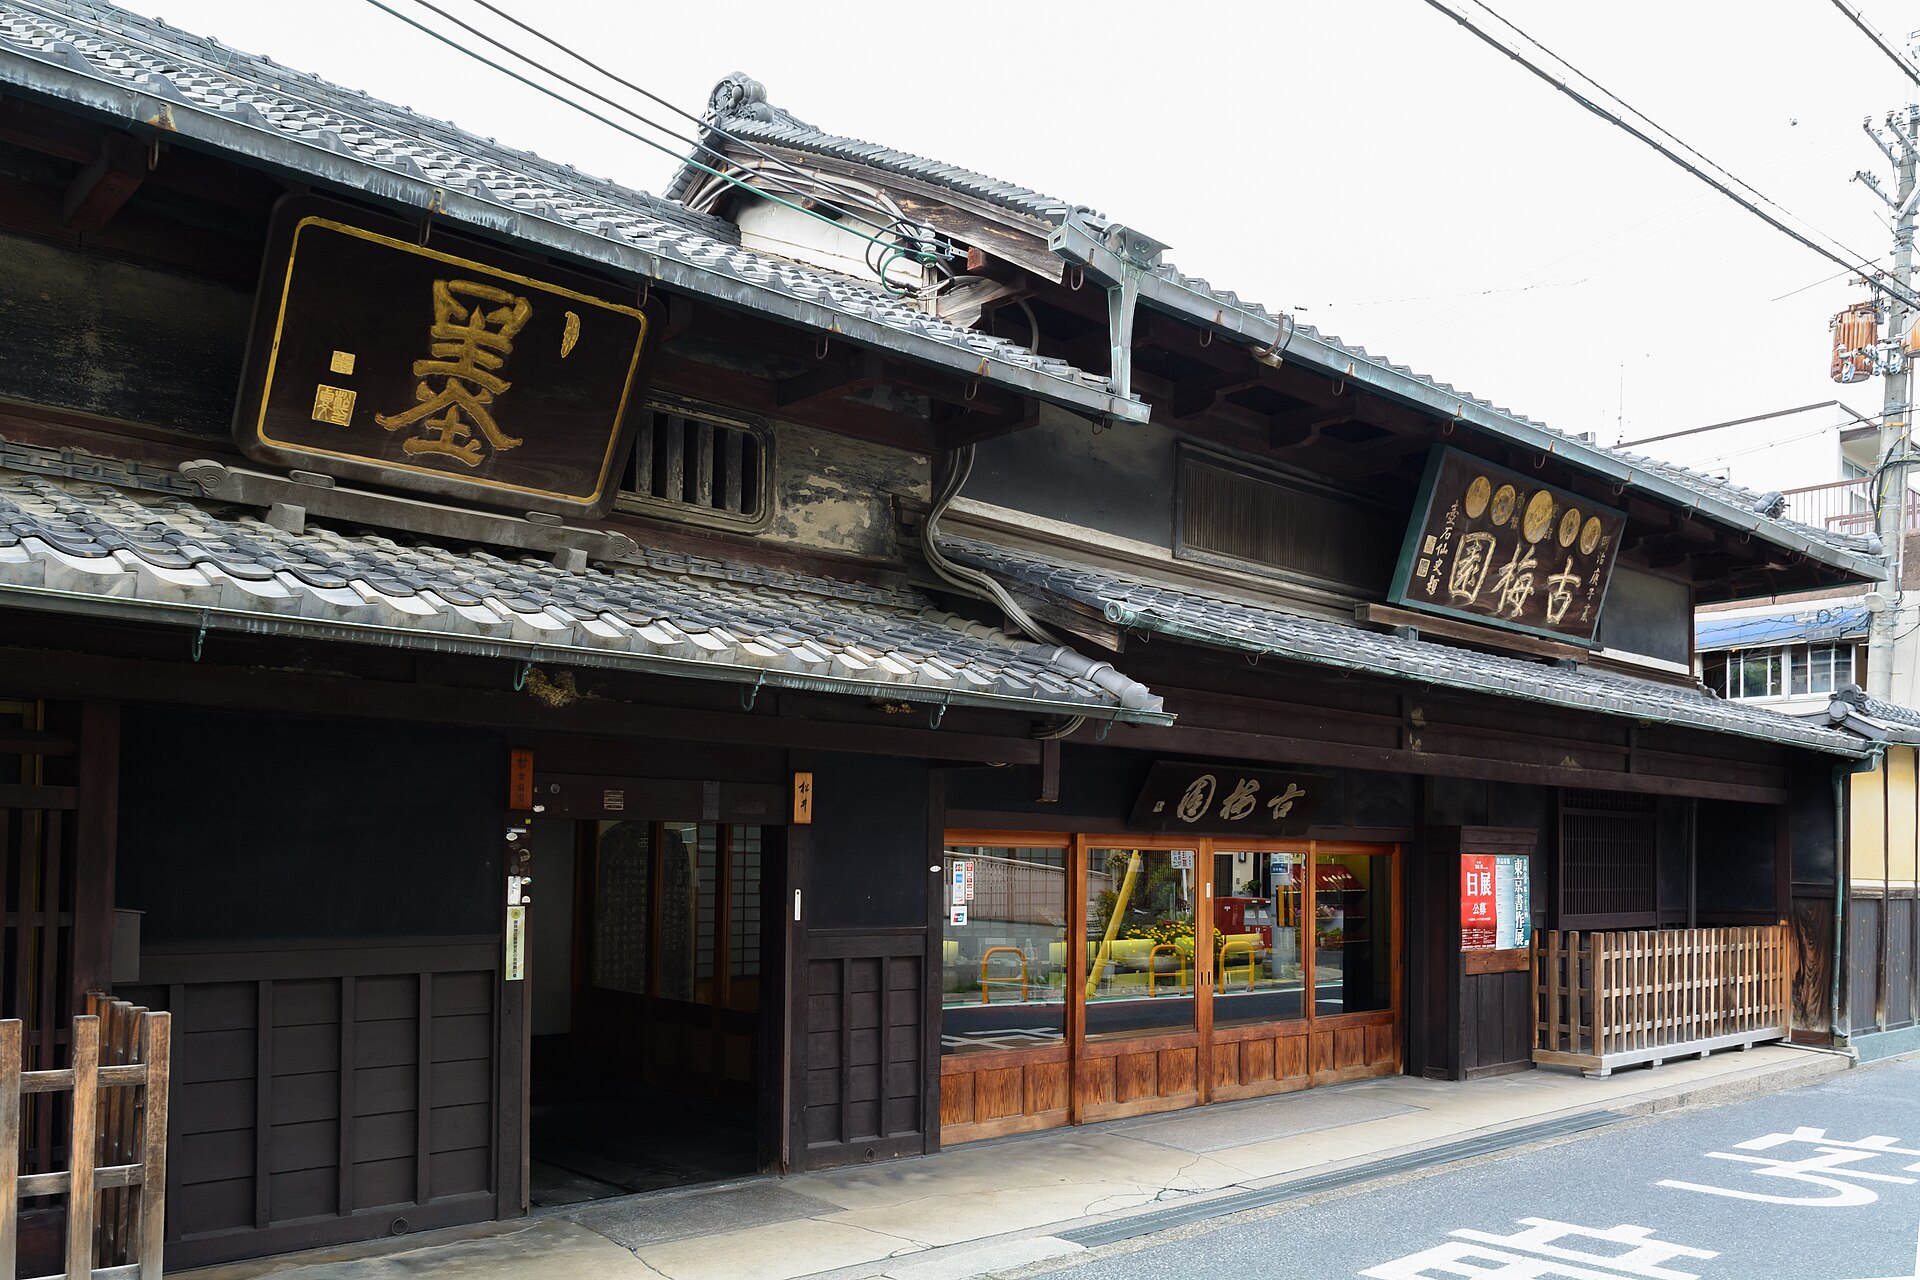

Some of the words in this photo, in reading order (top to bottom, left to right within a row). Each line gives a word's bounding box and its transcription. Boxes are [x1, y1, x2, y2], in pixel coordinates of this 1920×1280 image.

[375, 279, 532, 467] 墨
[1448, 532, 1582, 625] 古梅園
[798, 781, 810, 815] 松井
[1177, 774, 1306, 823] 古梅園
[1467, 872, 1492, 896] 日展
[1514, 857, 1525, 946] 東京書作展
[1472, 902, 1487, 916] 公募
